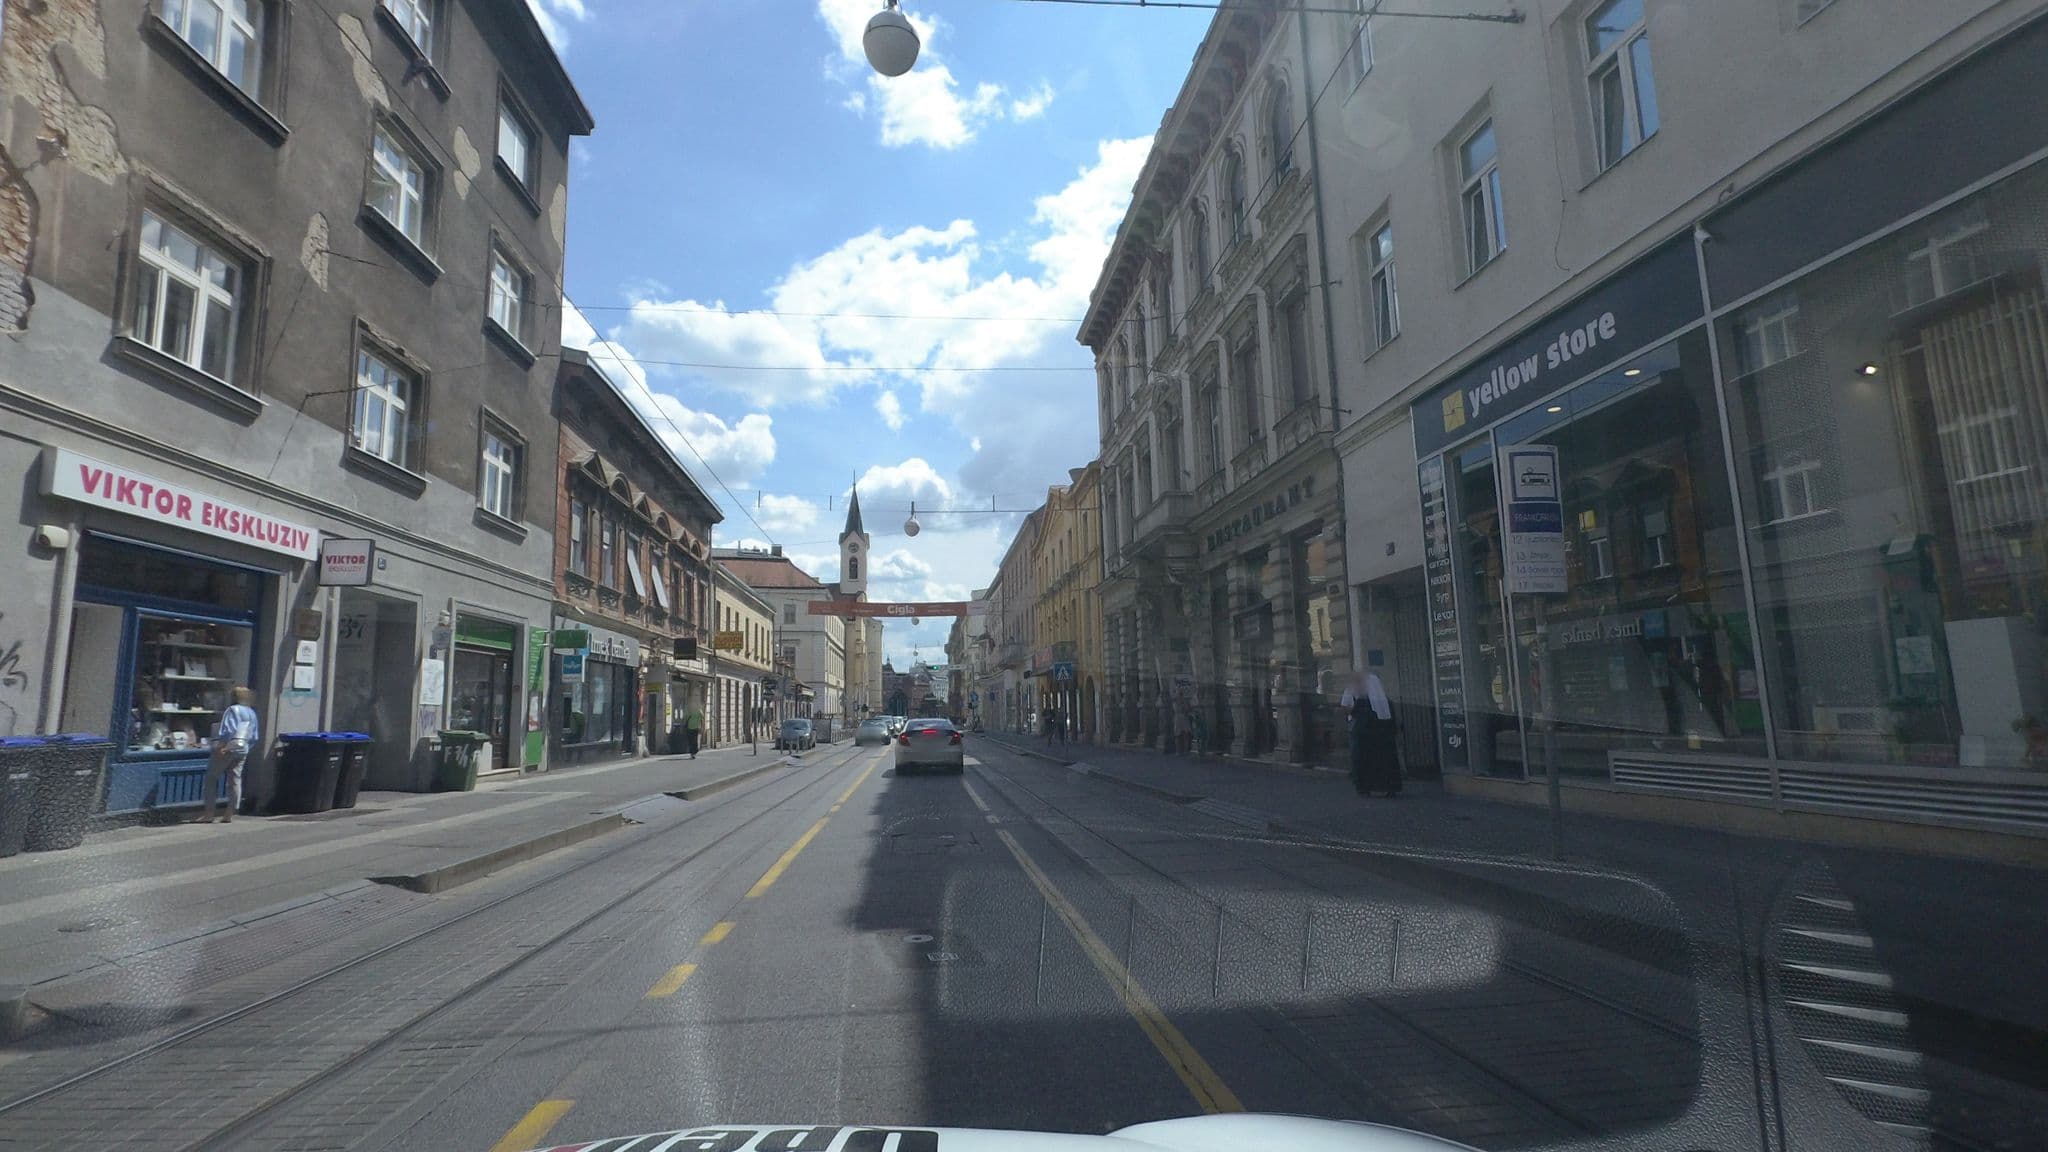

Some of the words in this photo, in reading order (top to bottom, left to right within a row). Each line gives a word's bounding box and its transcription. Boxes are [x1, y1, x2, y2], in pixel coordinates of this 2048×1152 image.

[1468, 354, 1538, 418] yellow
[1547, 312, 1616, 370] store
[79, 464, 192, 521] VIKTOR
[201, 502, 310, 552] EKSKLUZIV
[325, 555, 366, 564] VIKTOR
